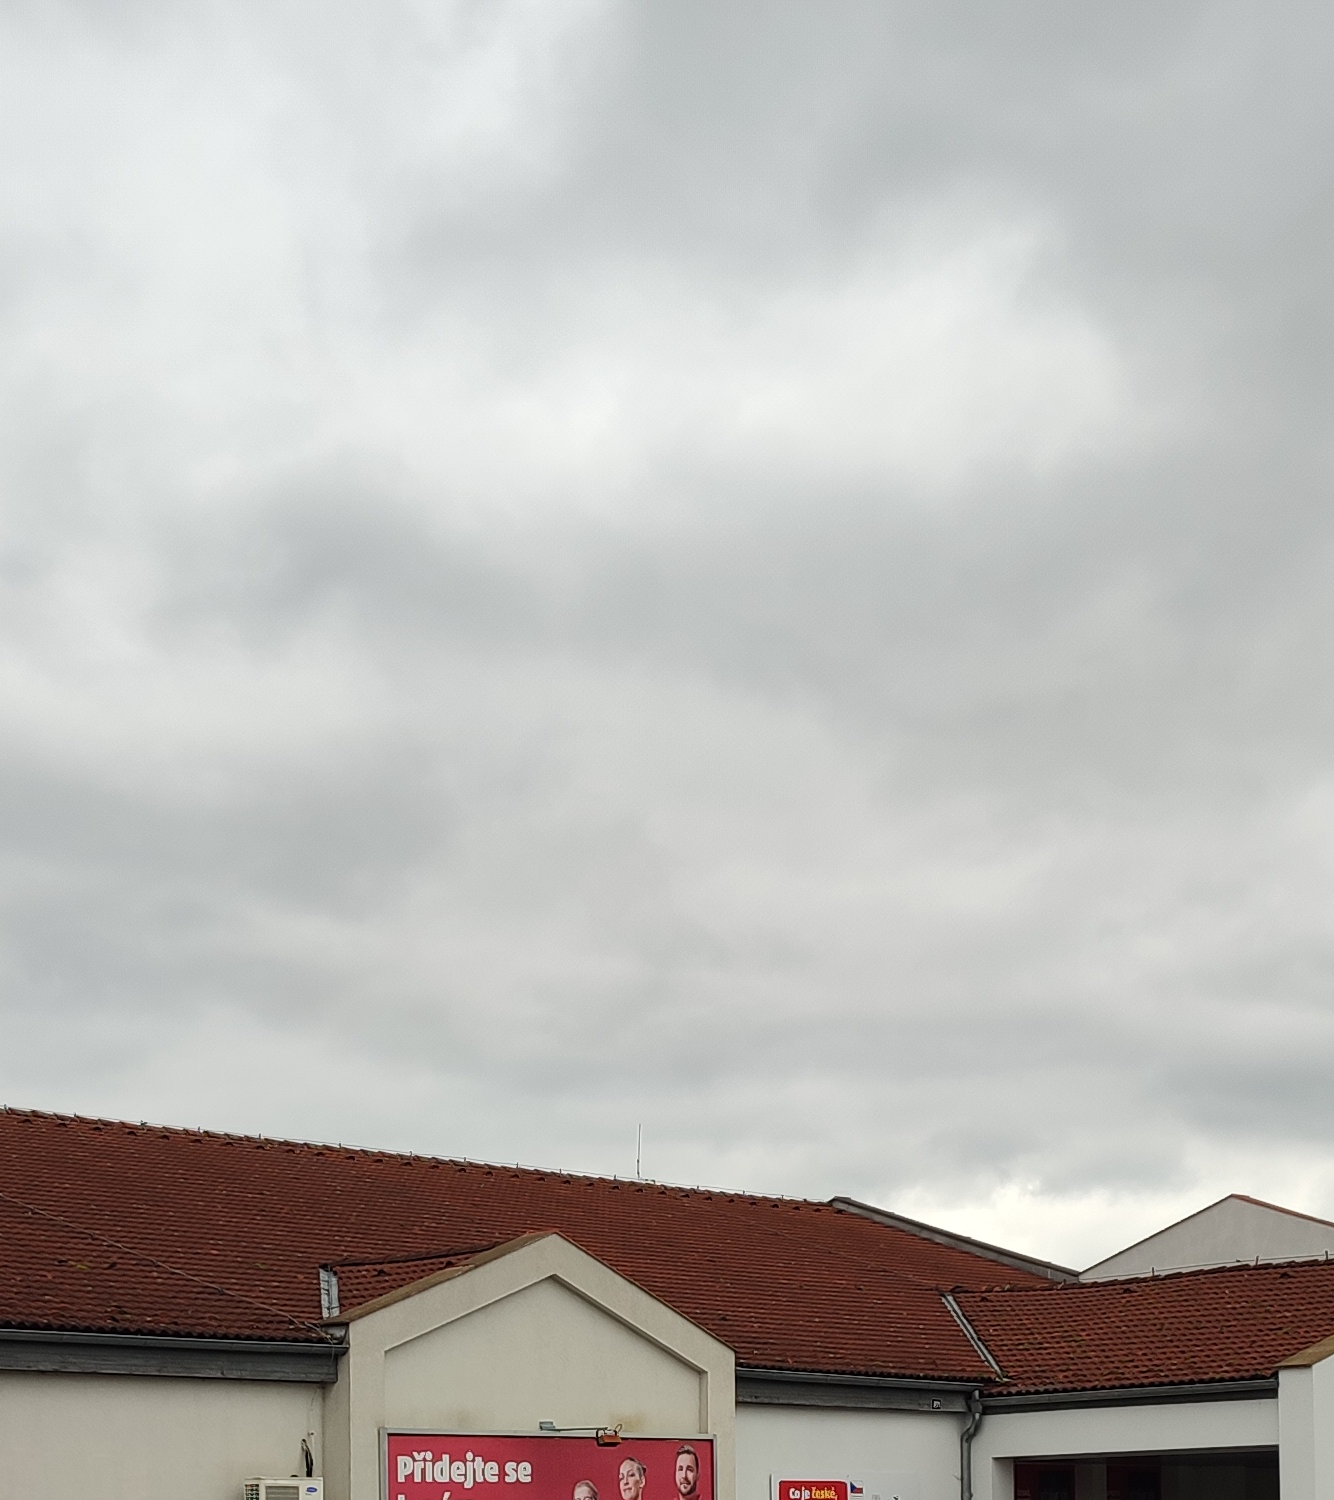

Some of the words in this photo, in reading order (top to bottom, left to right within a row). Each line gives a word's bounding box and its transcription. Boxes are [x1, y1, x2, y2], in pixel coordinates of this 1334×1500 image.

[397, 1451, 499, 1488] Přidejte
[504, 1461, 532, 1483] se
[789, 1487, 800, 1499] Co
[801, 1486, 810, 1500] je
[811, 1486, 838, 1500] české,
